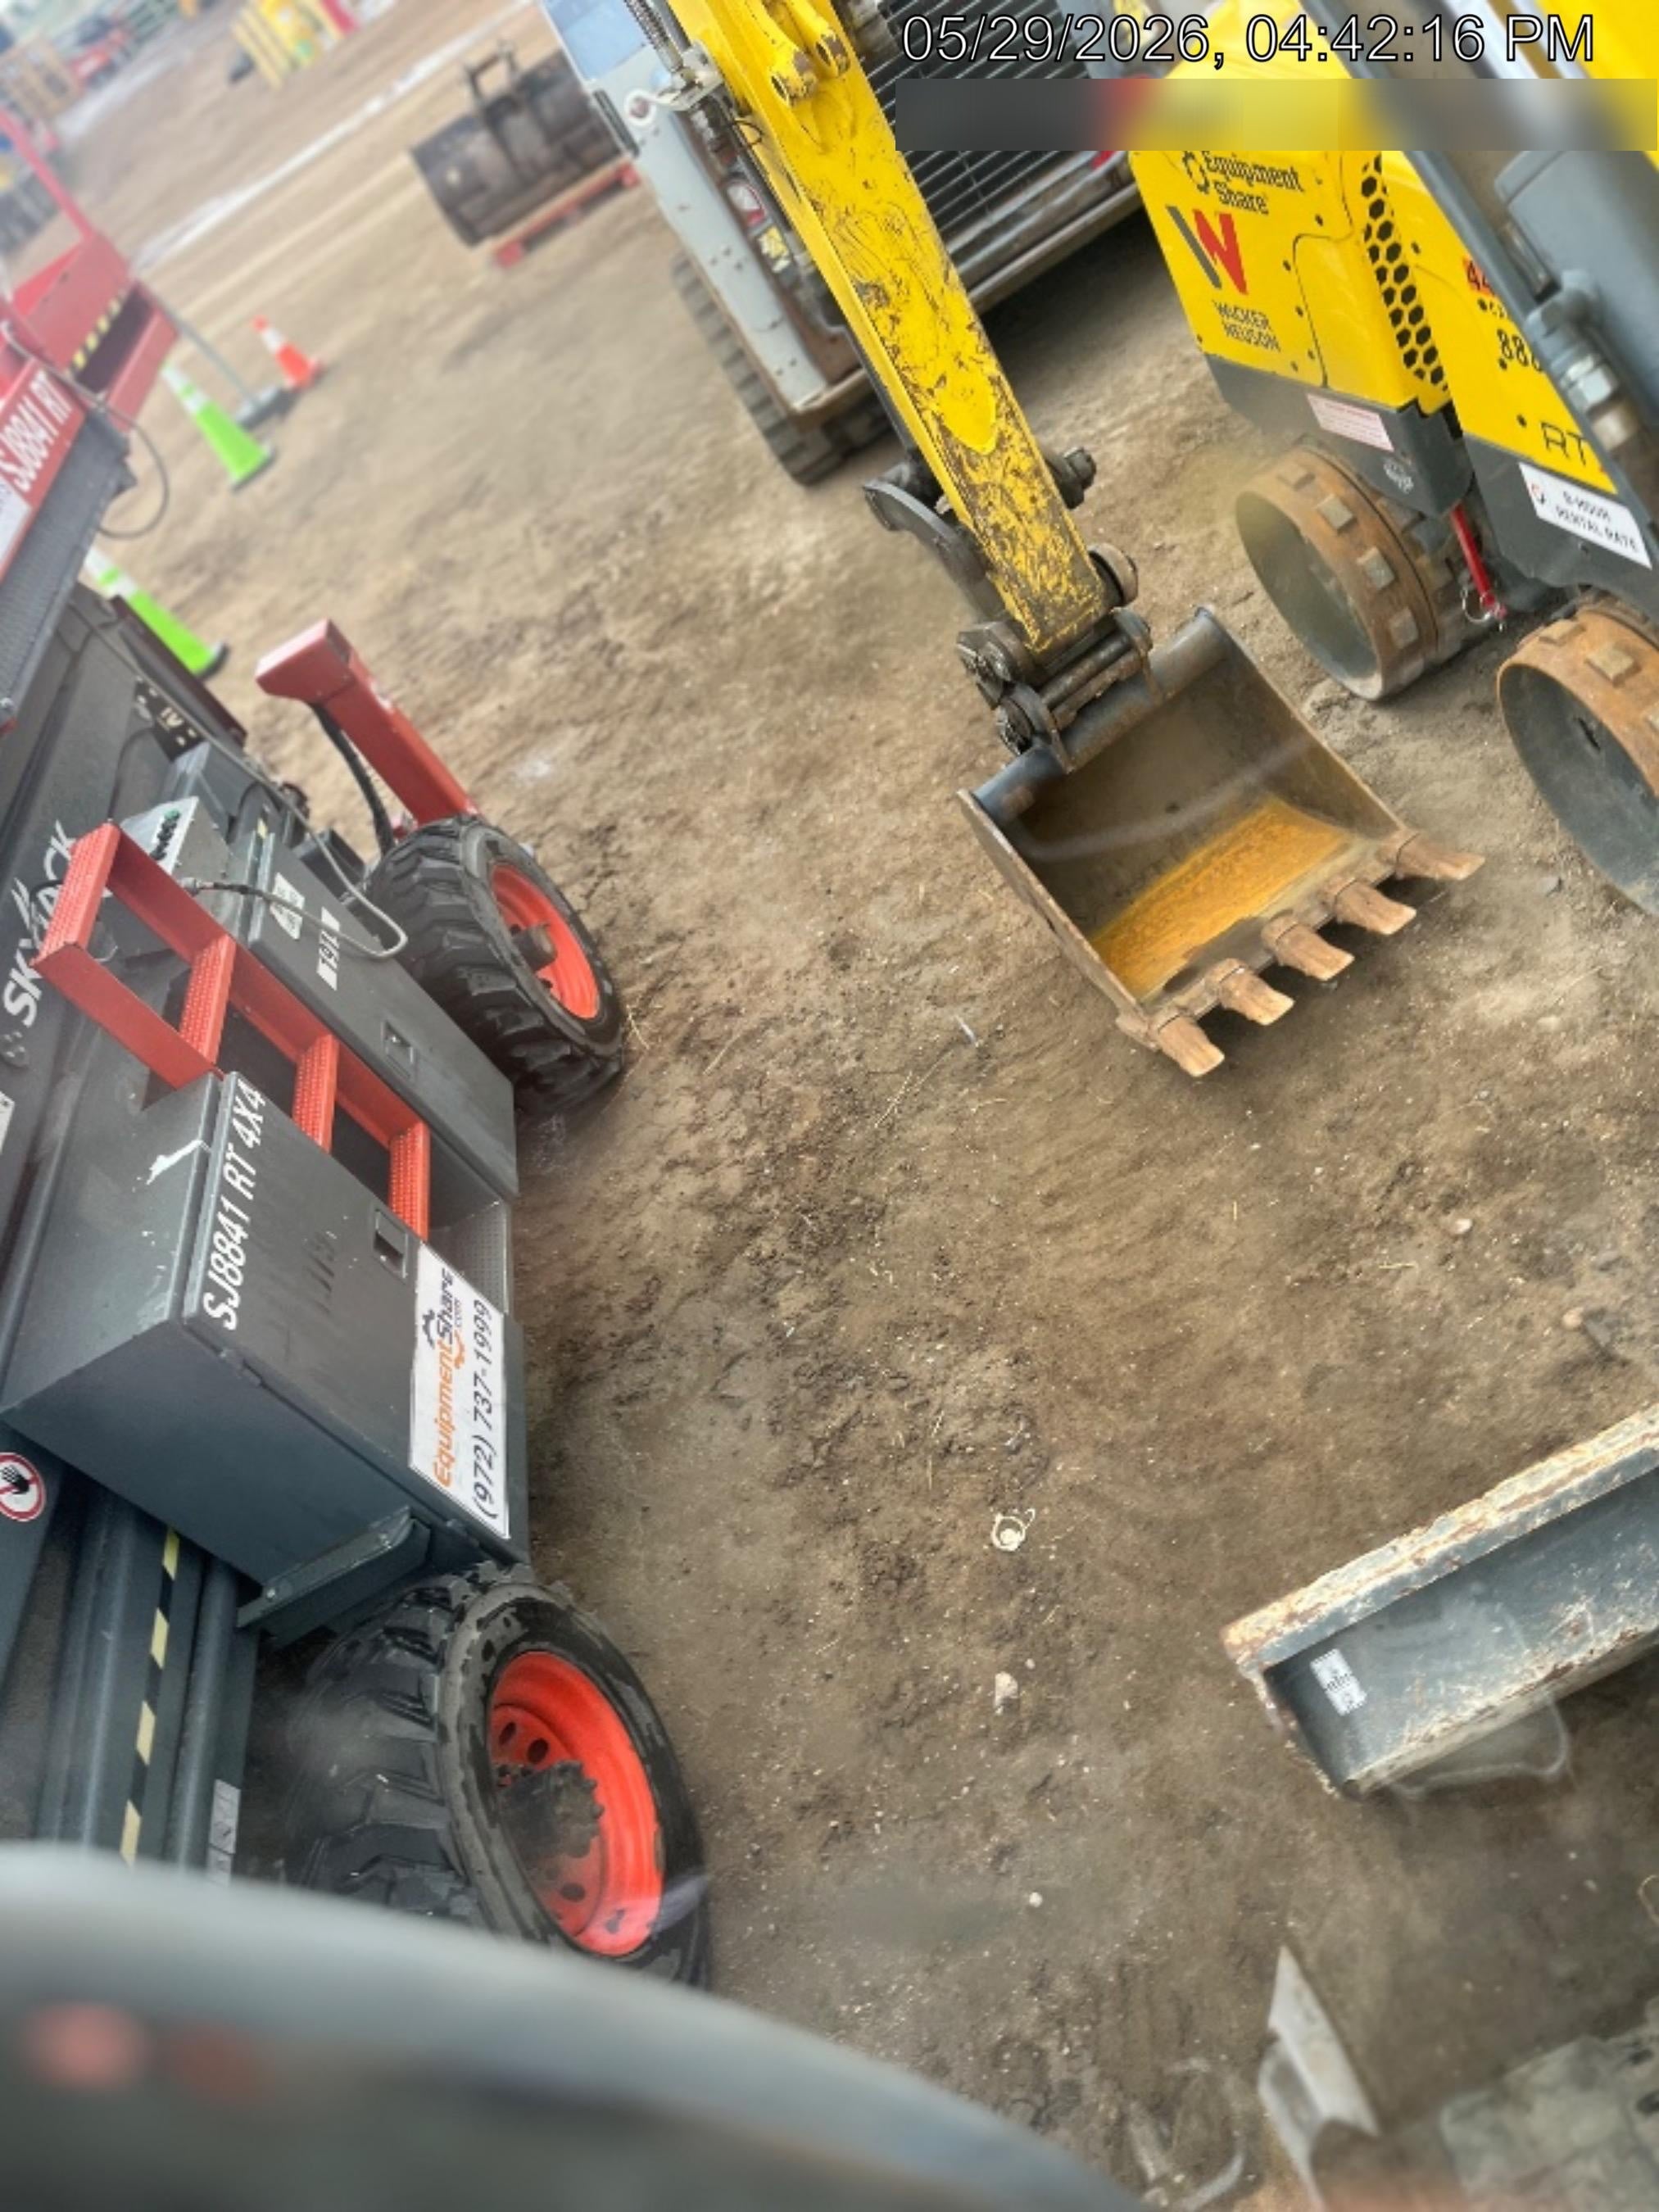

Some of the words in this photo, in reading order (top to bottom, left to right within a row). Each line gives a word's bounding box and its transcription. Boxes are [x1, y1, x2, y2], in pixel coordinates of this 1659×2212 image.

[232, 1077, 266, 1149] 4X4
[222, 1142, 257, 1201] RT
[203, 1194, 251, 1330] SJ8841
[473, 1299, 493, 1430] 737-1999
[473, 1435, 497, 1520] (972)
